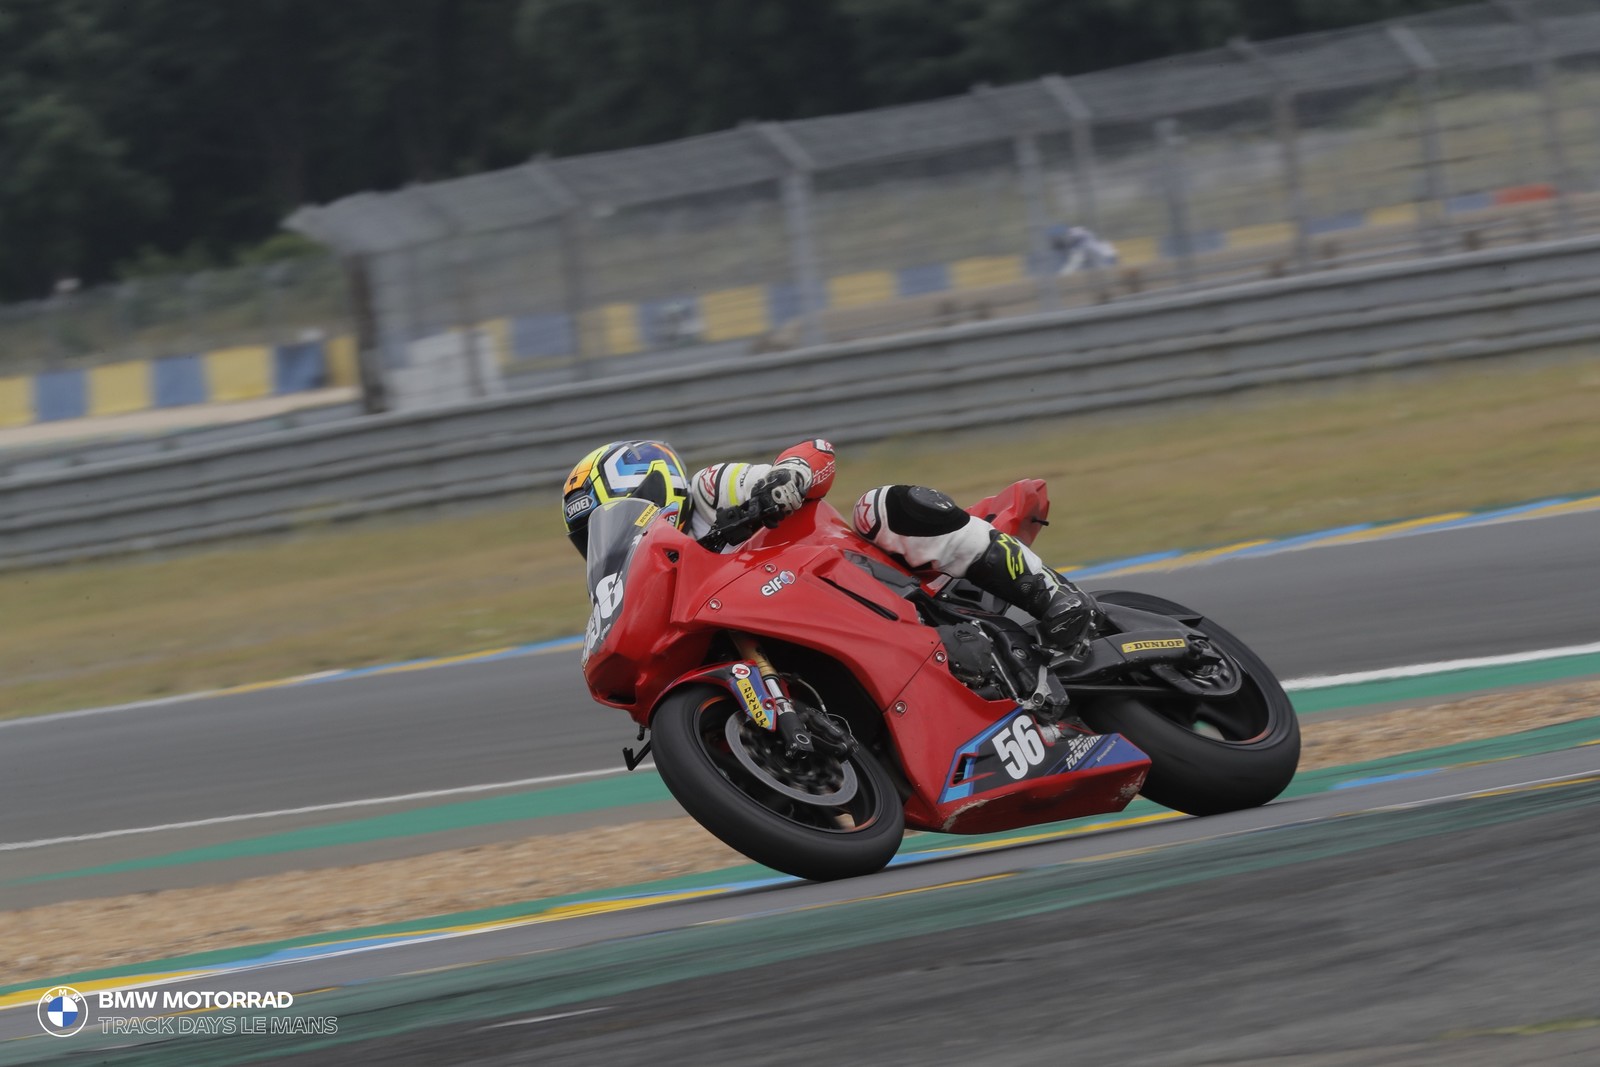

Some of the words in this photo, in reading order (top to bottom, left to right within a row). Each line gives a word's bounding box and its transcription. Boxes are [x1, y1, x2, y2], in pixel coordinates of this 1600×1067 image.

[567, 498, 590, 518] SHOEI
[761, 576, 783, 596] elf
[1134, 640, 1183, 650] DUNLOP
[743, 686, 768, 727] DUNLOP
[992, 714, 1045, 780] 56
